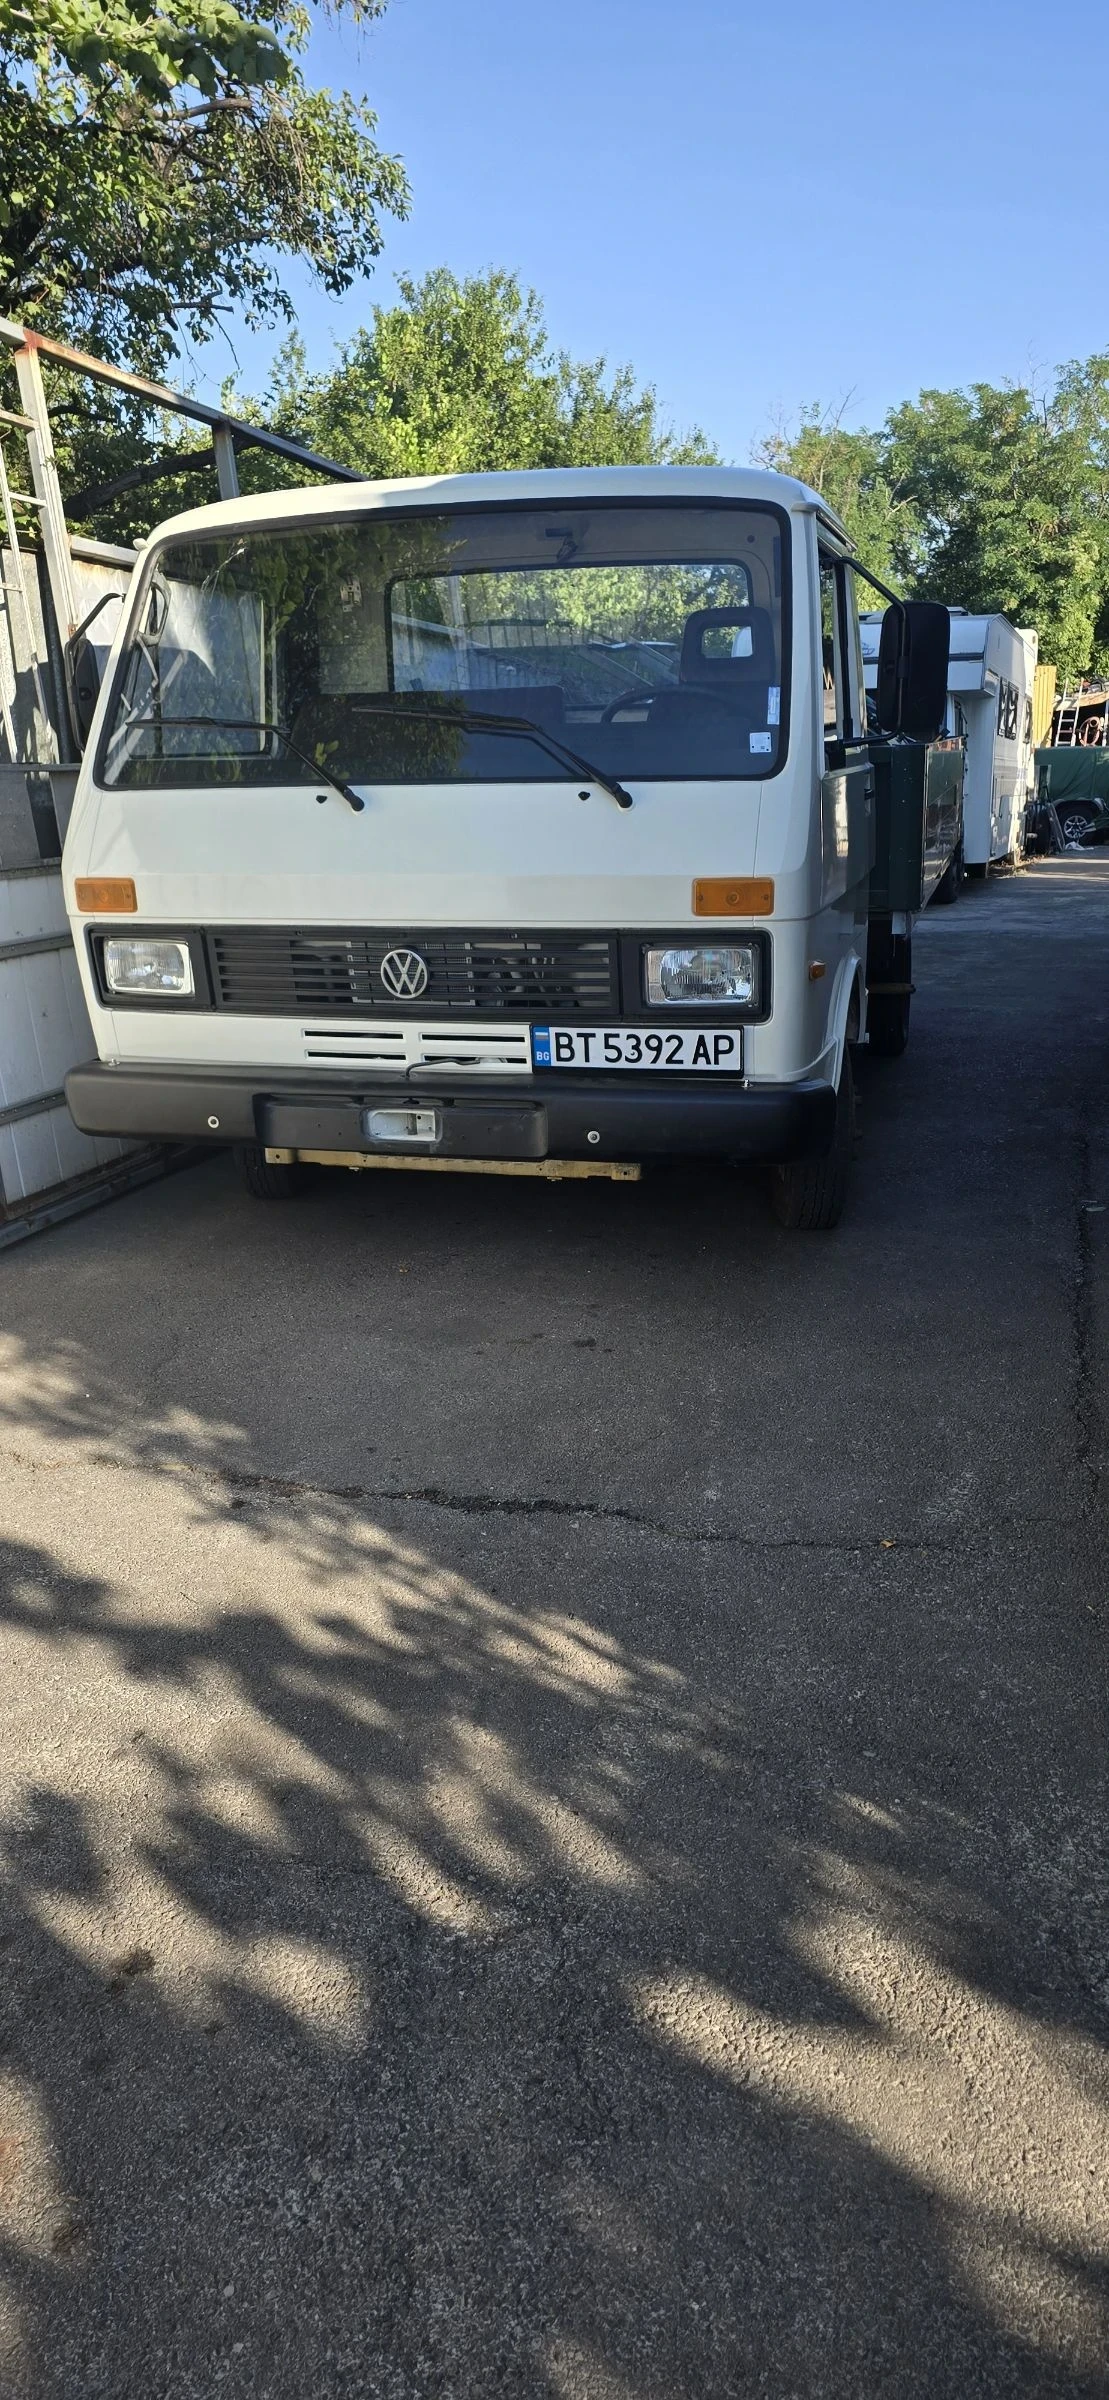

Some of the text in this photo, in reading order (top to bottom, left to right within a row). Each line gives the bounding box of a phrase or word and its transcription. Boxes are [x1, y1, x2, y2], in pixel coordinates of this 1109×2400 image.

[381, 949, 427, 998] VW
[536, 1051, 549, 1061] BG
[555, 1032, 734, 1065] BT 5392 AP
